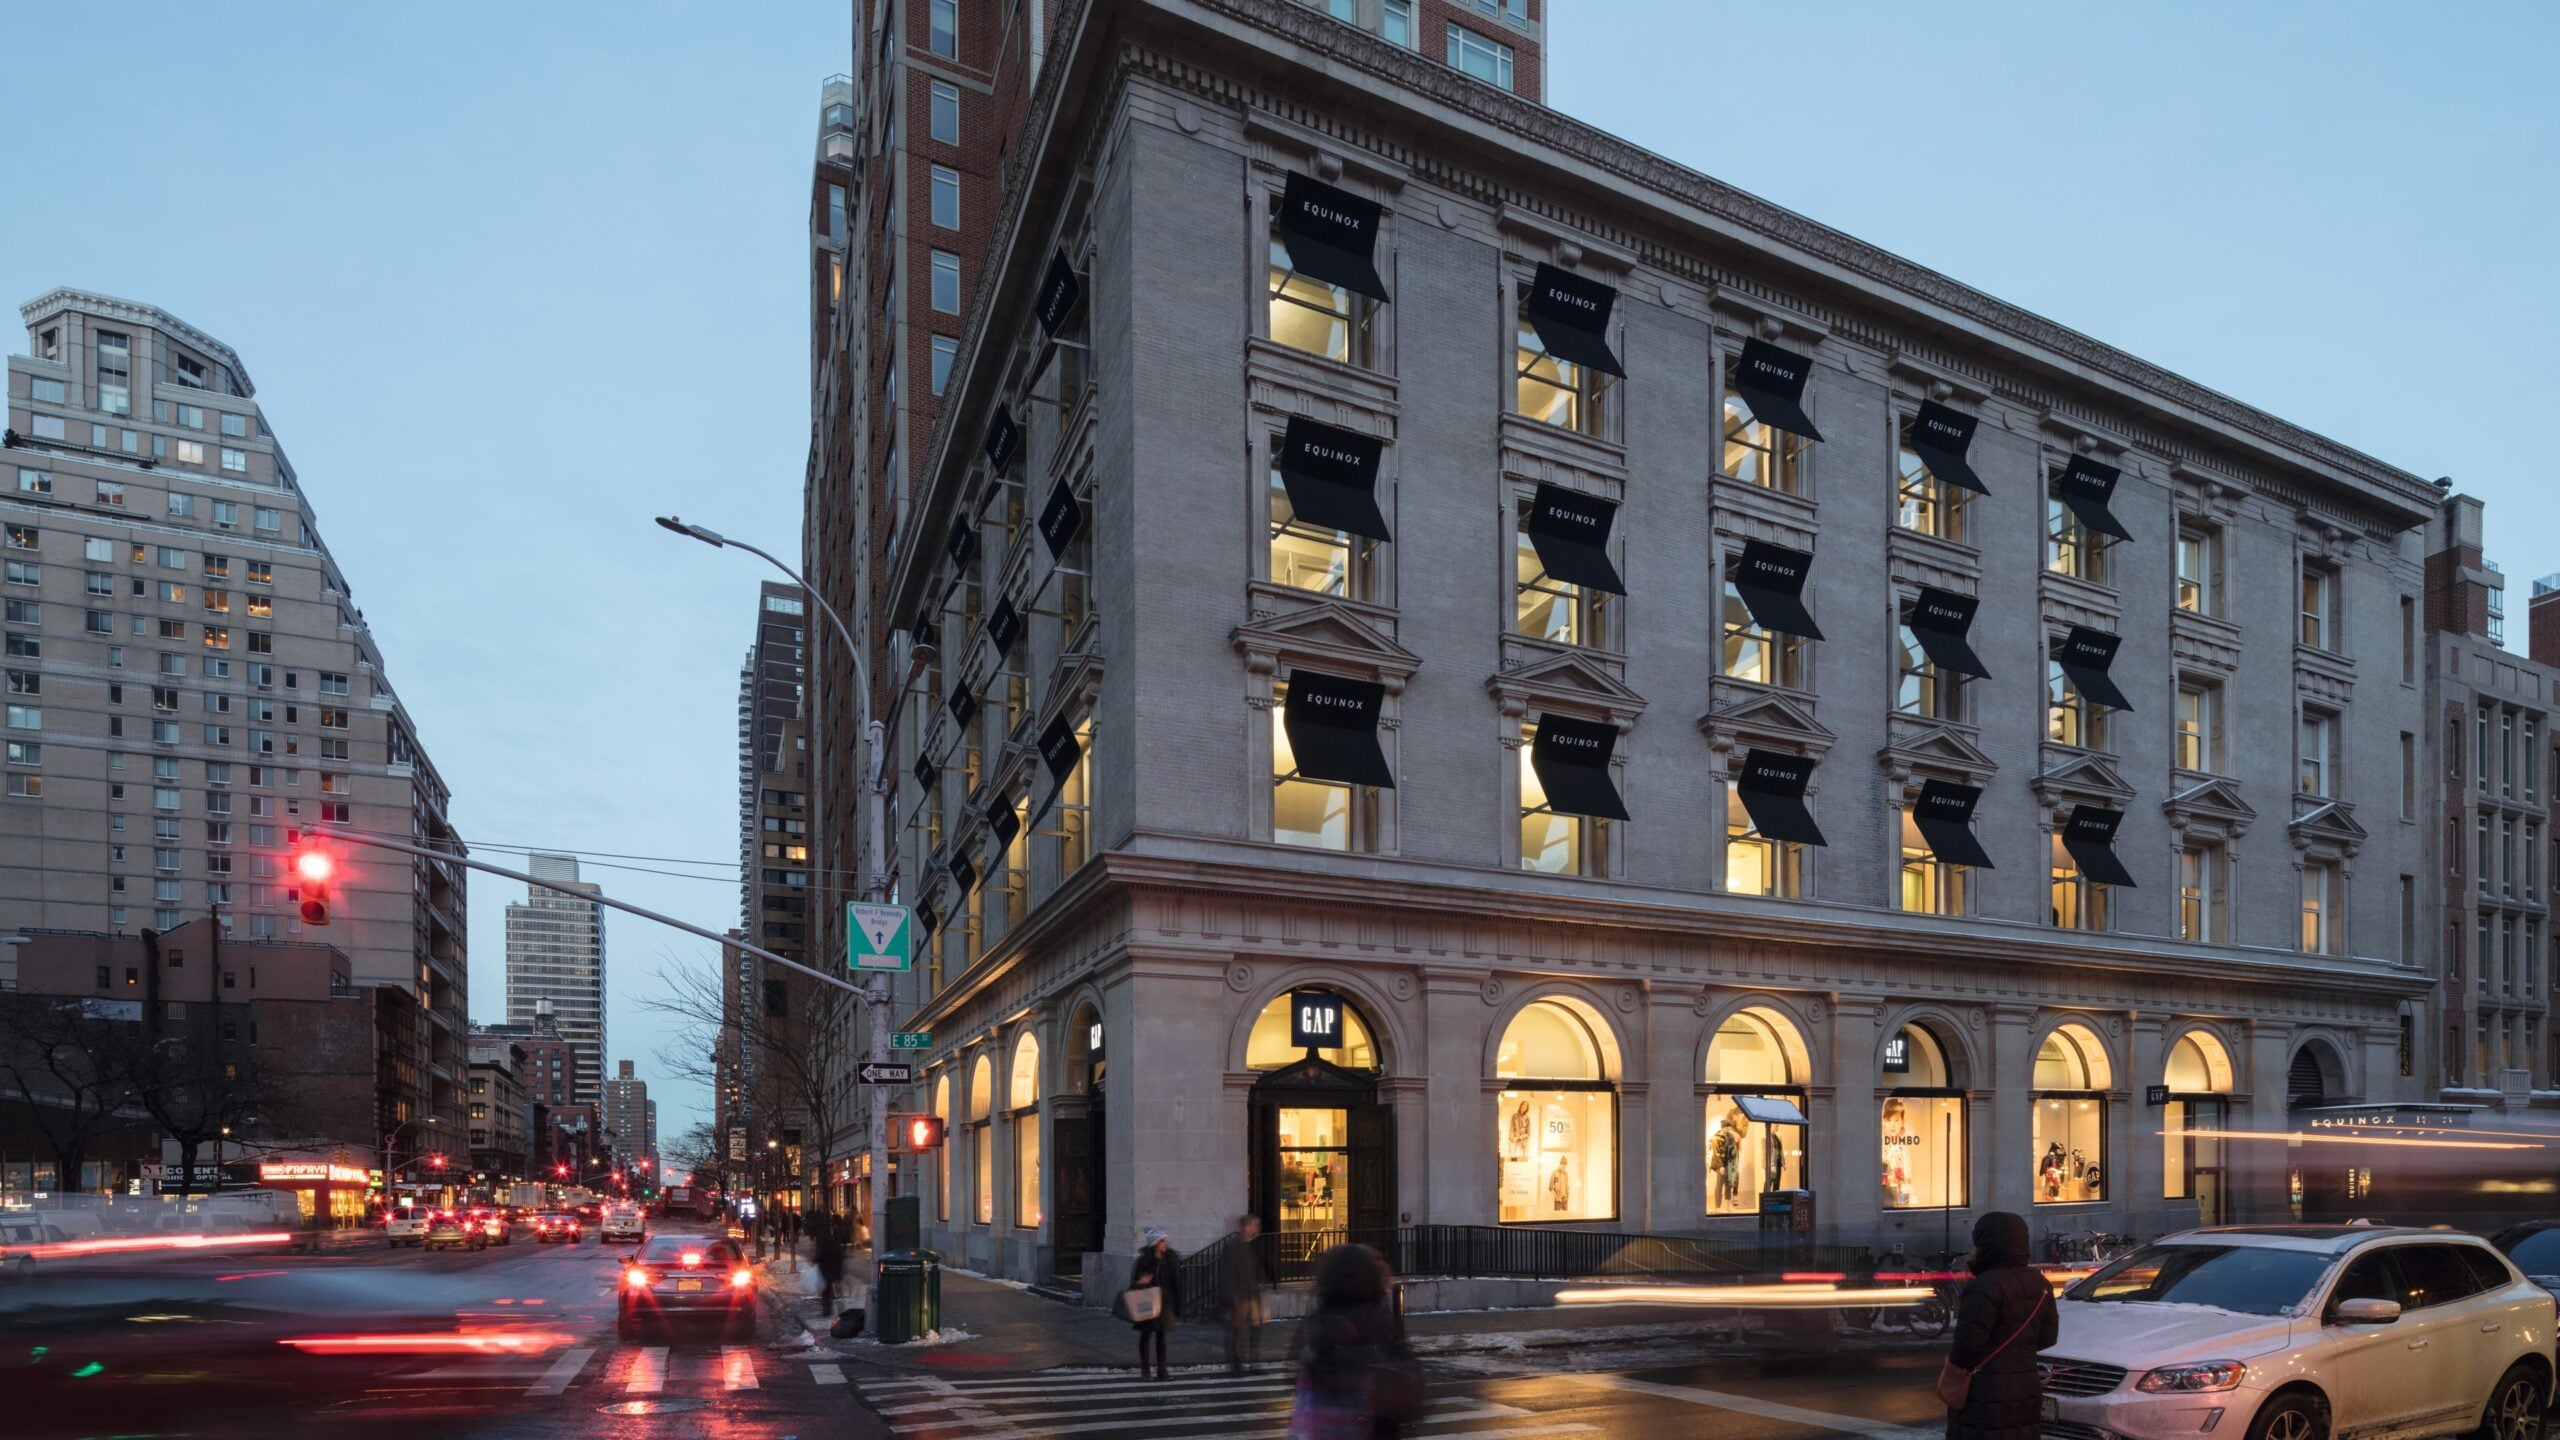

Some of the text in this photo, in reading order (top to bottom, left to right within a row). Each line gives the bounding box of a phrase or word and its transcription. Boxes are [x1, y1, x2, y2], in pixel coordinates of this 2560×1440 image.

[1304, 201, 1359, 229] EQUINOX
[1047, 278, 1065, 322] EQUINOX
[1550, 289, 1596, 311] EQUINOX
[1755, 360, 1794, 380] EQUINOX
[1928, 420, 1962, 437] EQUINOX
[1305, 443, 1360, 465] EQUINOX
[2076, 472, 2106, 487] EQUINOX
[1549, 507, 1596, 526] EQUINOX
[1755, 561, 1795, 576] EQUINOX
[1929, 605, 1962, 619] EQUINOX
[2077, 643, 2106, 655] EQUINOX
[1307, 694, 1362, 709] EQUINOX
[1552, 735, 1599, 748] EQUINOX
[1758, 768, 1797, 780] EQUINOX
[1931, 796, 1965, 807] EQUINOX
[2079, 820, 2109, 829] EQUINOX
[880, 910, 902, 918] Kennedy
[871, 919, 888, 927] Bridge
[1302, 1006, 1334, 1034] GAP
[892, 1034, 899, 1047] E
[903, 1034, 918, 1047] 85
[866, 1069, 905, 1078] ONE WAY
[2311, 1115, 2394, 1127] EQUINOX
[1884, 1135, 1920, 1146] DUMBO
[167, 1167, 218, 1175] COEN'S
[286, 1165, 327, 1175] PAPAYA
